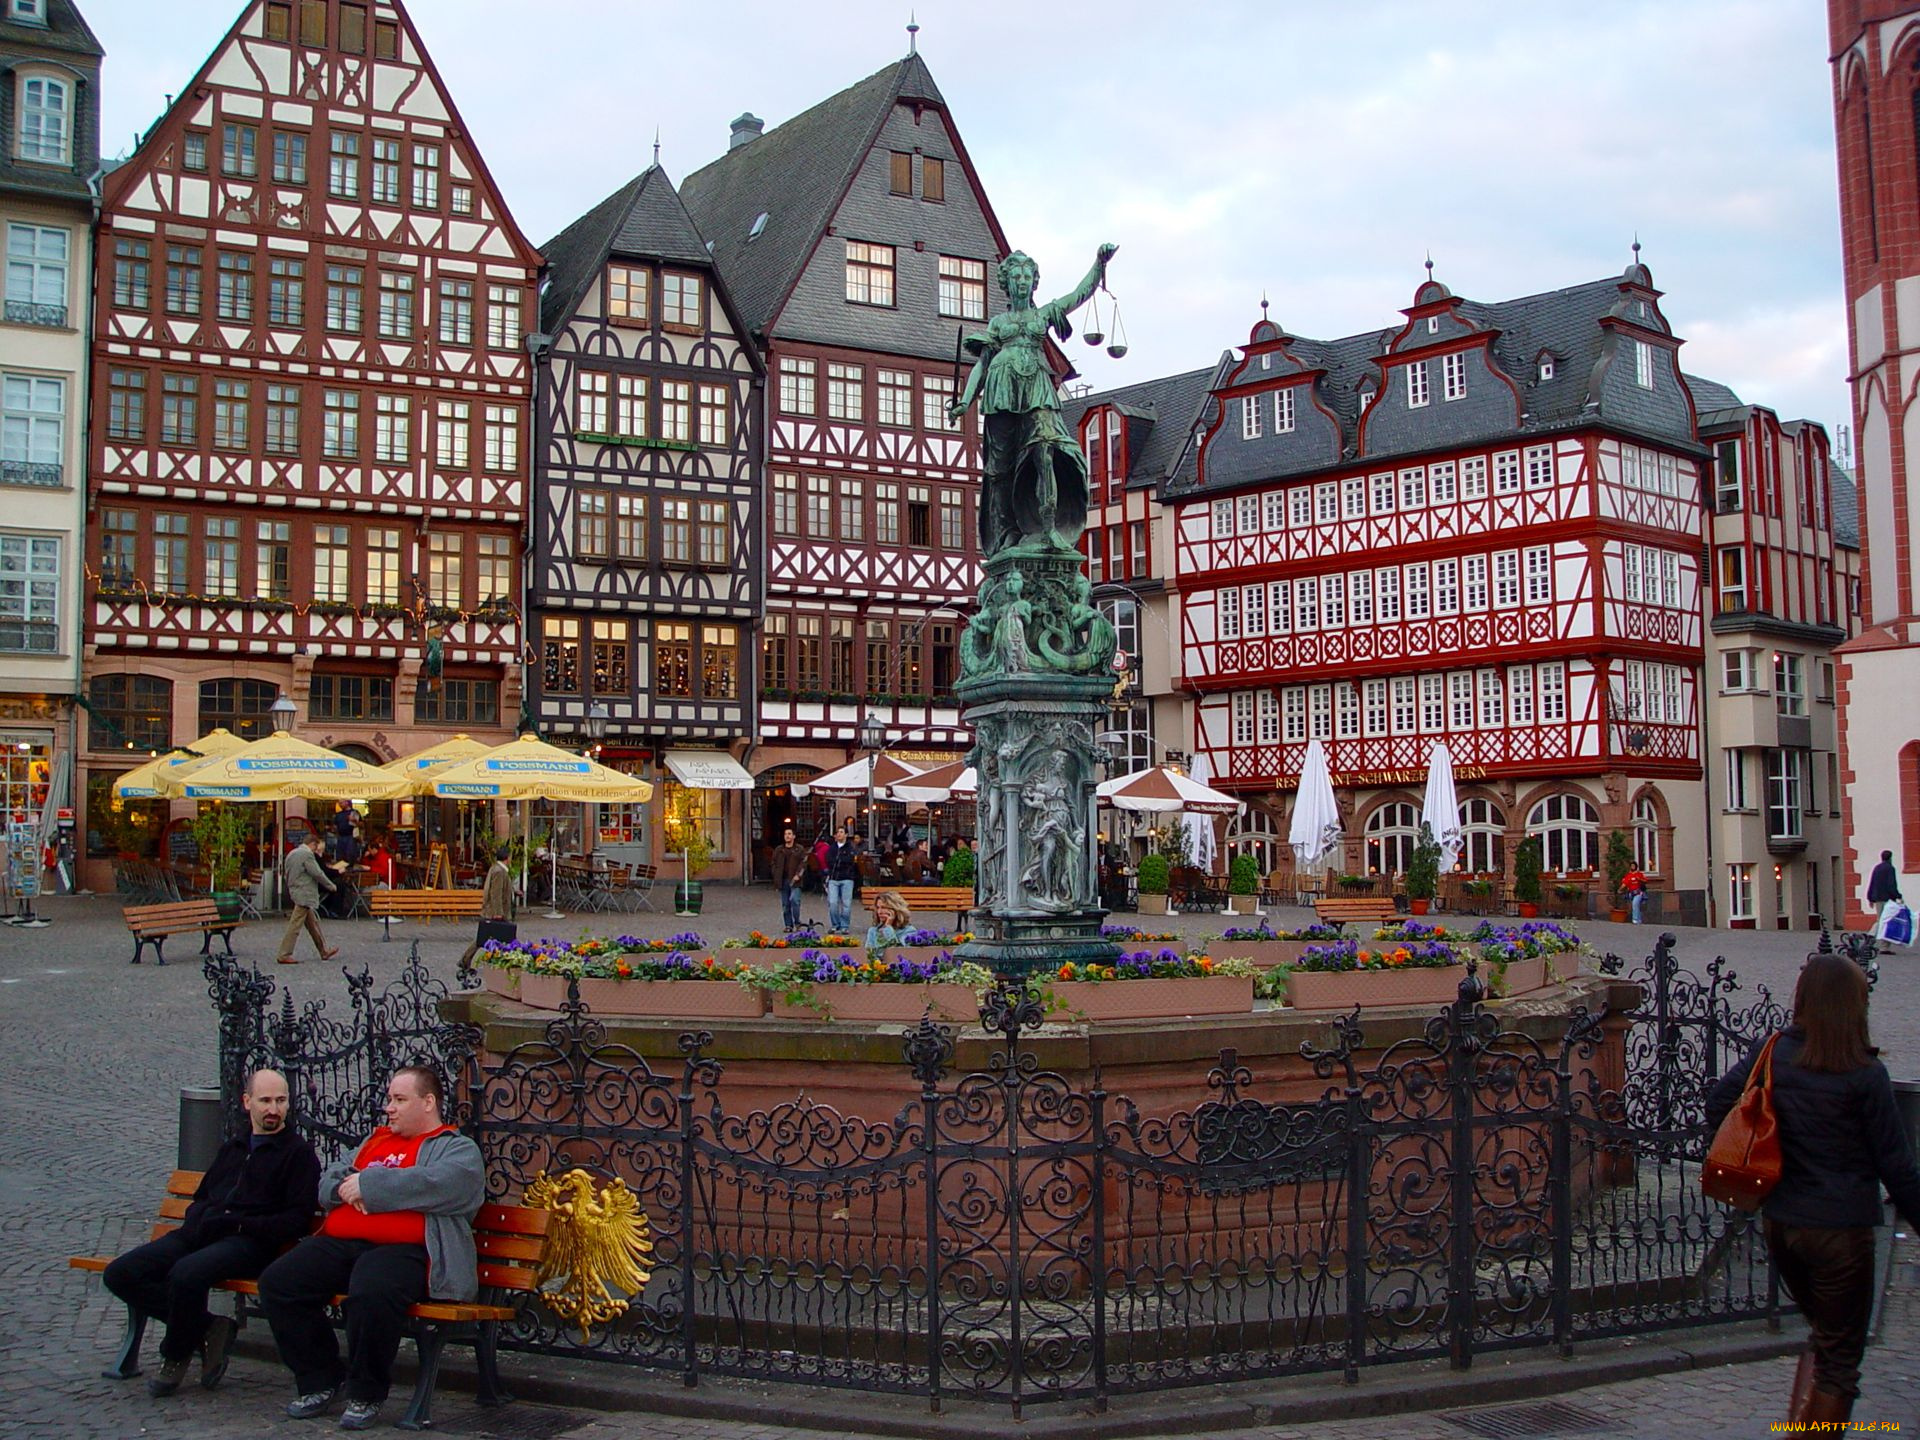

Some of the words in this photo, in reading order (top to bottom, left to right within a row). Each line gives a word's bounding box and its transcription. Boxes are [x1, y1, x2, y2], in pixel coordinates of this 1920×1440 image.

[251, 759, 335, 769] POSSMANN
[499, 761, 580, 771] POSSMANN
[1358, 768, 1428, 785] SCHWARZE
[1453, 765, 1488, 780] TERN
[193, 786, 244, 796] POSSMANN
[445, 785, 494, 794] POSSMANN
[511, 786, 528, 795] Aus
[531, 786, 569, 796] Tradition
[572, 788, 590, 797] und
